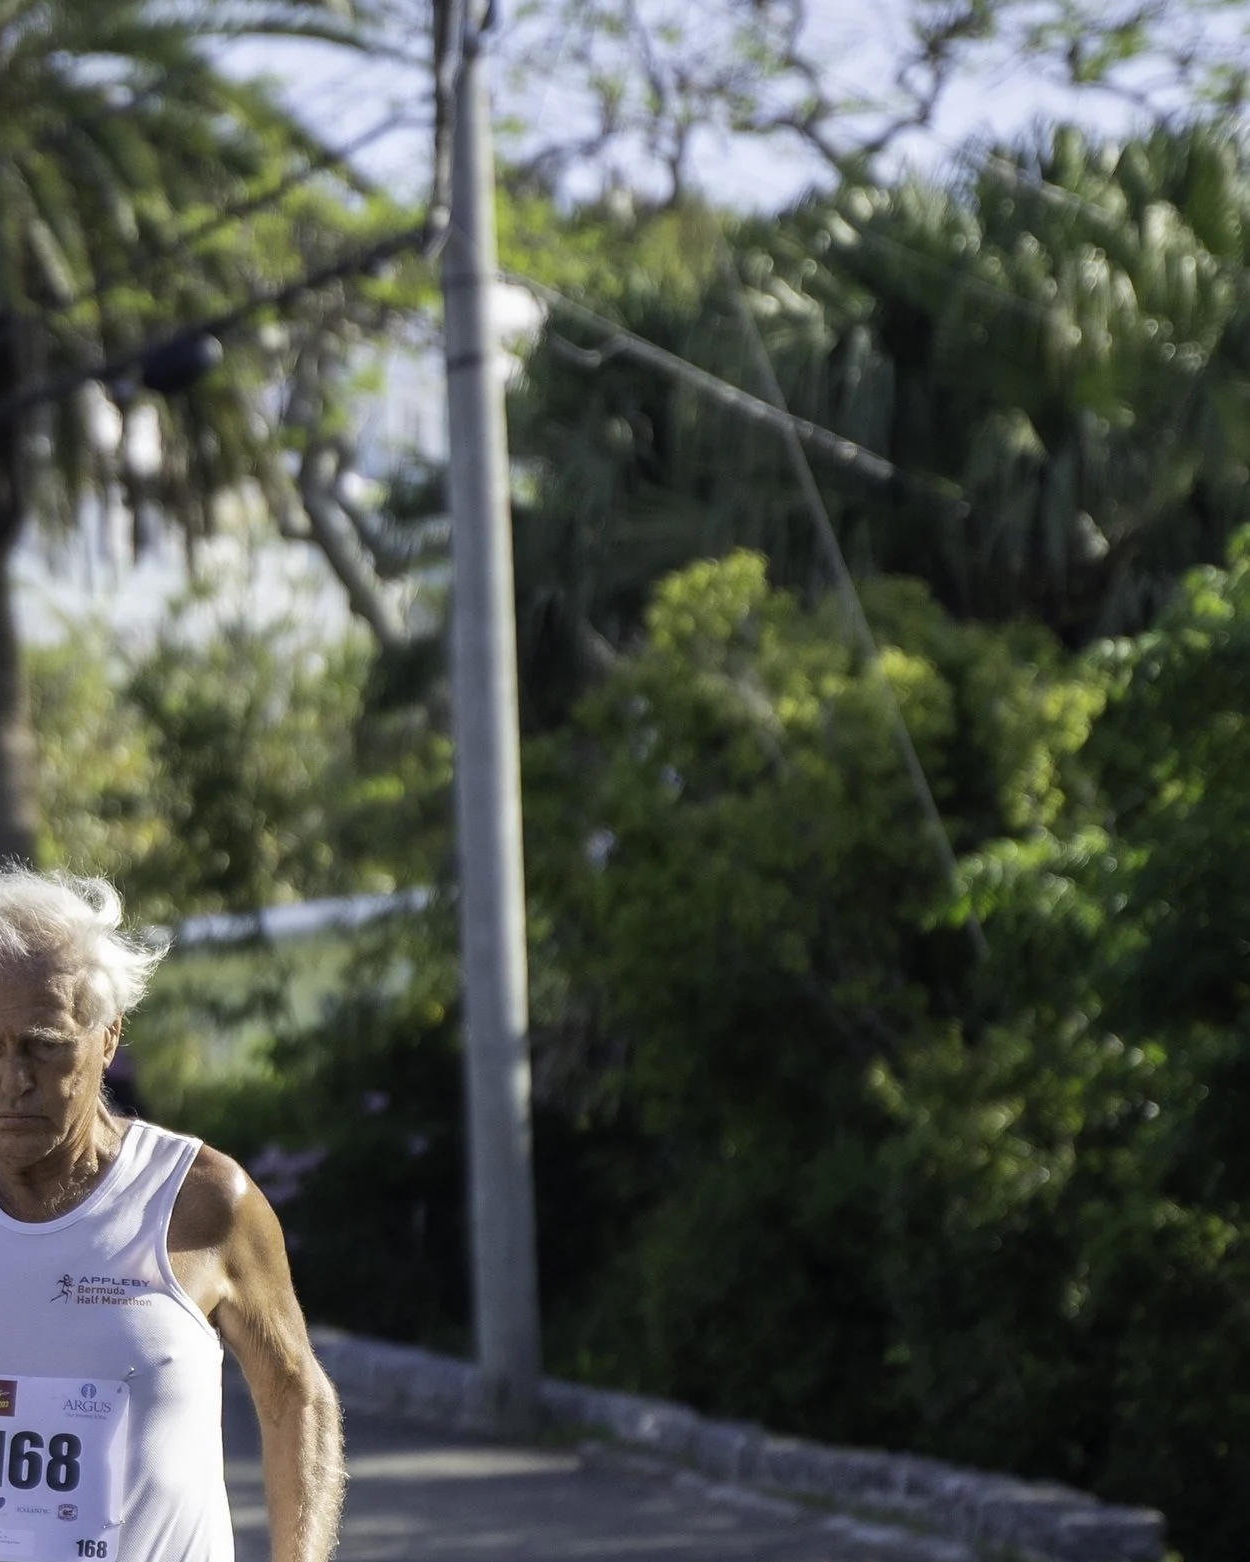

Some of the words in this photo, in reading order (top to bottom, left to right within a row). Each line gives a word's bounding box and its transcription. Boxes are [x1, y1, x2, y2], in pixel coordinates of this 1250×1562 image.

[79, 1276, 150, 1287] APPLEBY
[77, 1285, 125, 1295] Bermuda
[76, 1295, 99, 1304] Half
[101, 1296, 152, 1306] Marathon
[62, 1399, 112, 1413] ARGUS
[76, 1539, 108, 1558] 168
